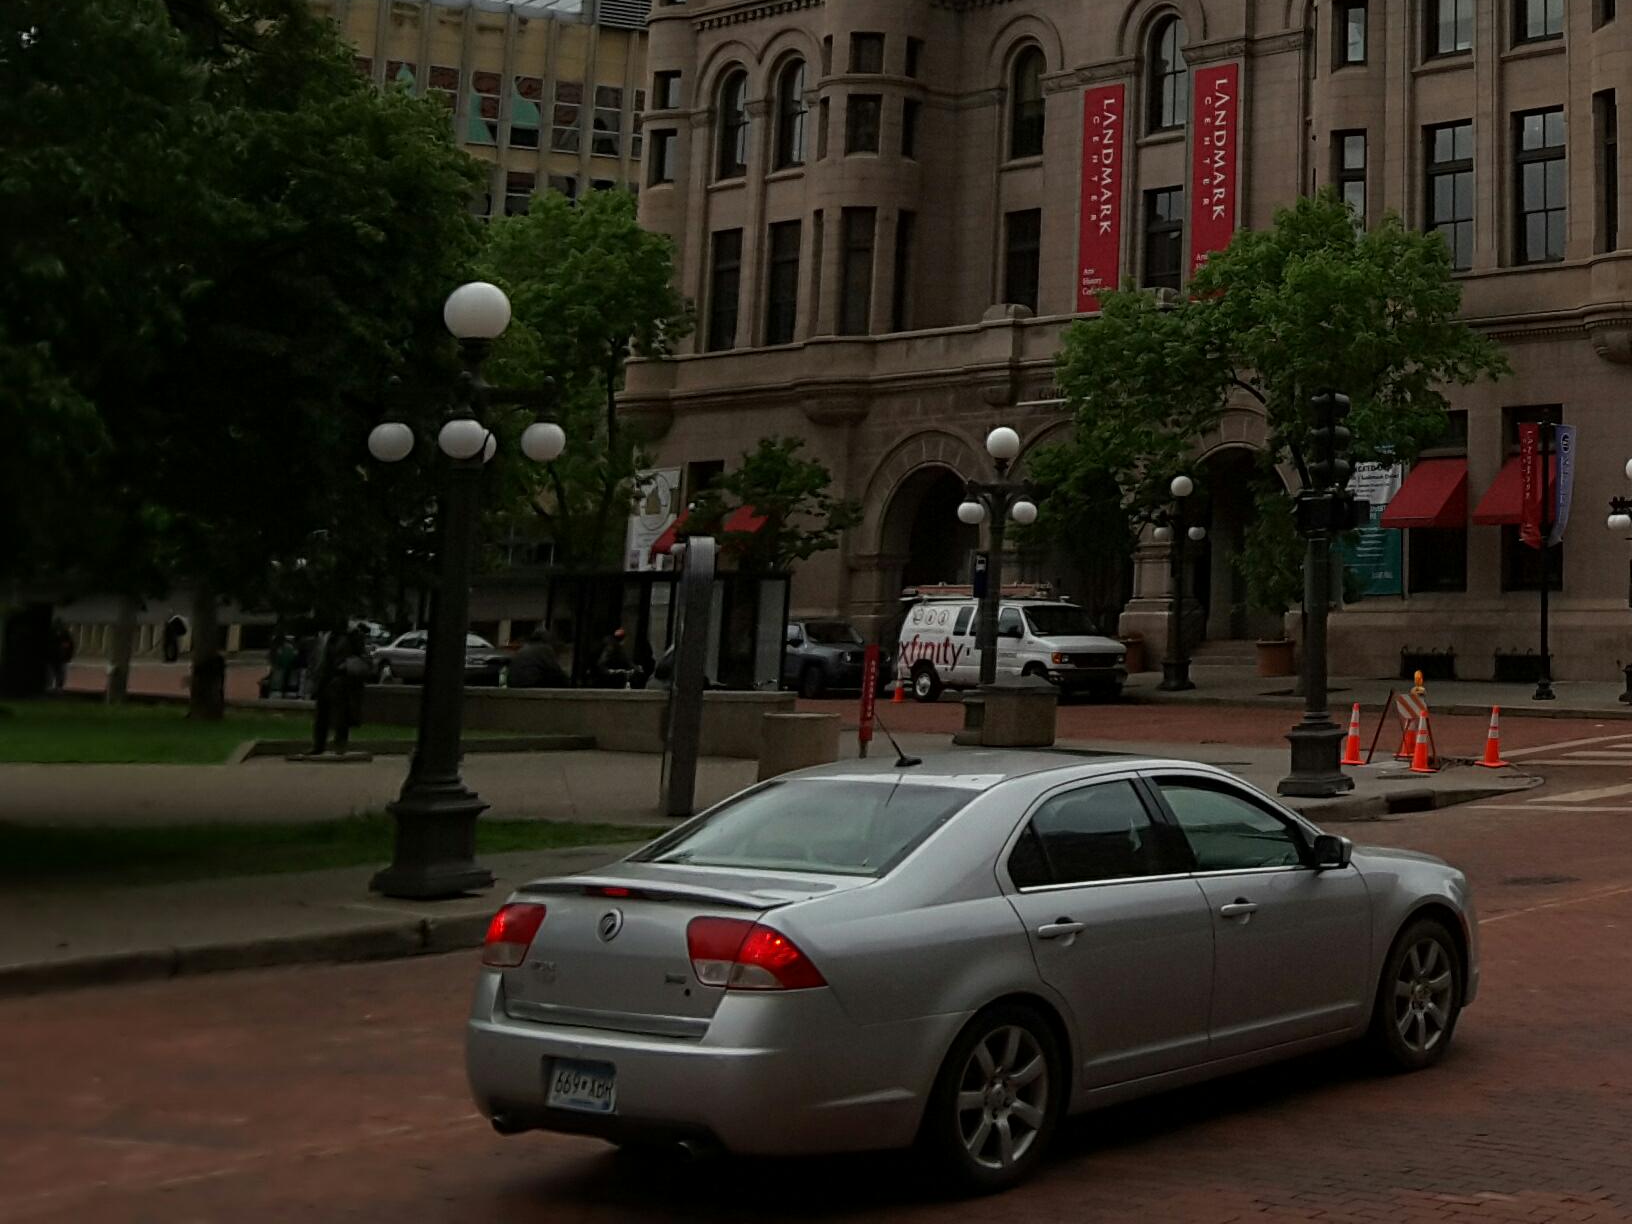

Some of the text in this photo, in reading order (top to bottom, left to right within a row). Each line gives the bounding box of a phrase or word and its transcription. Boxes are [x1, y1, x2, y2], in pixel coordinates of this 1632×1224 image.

[1090, 116, 1100, 221] CENTER
[1099, 97, 1117, 236] LANDMARK
[1202, 96, 1211, 206] CENTER
[1212, 78, 1231, 221] LANDMARK
[898, 633, 965, 672] xfinity
